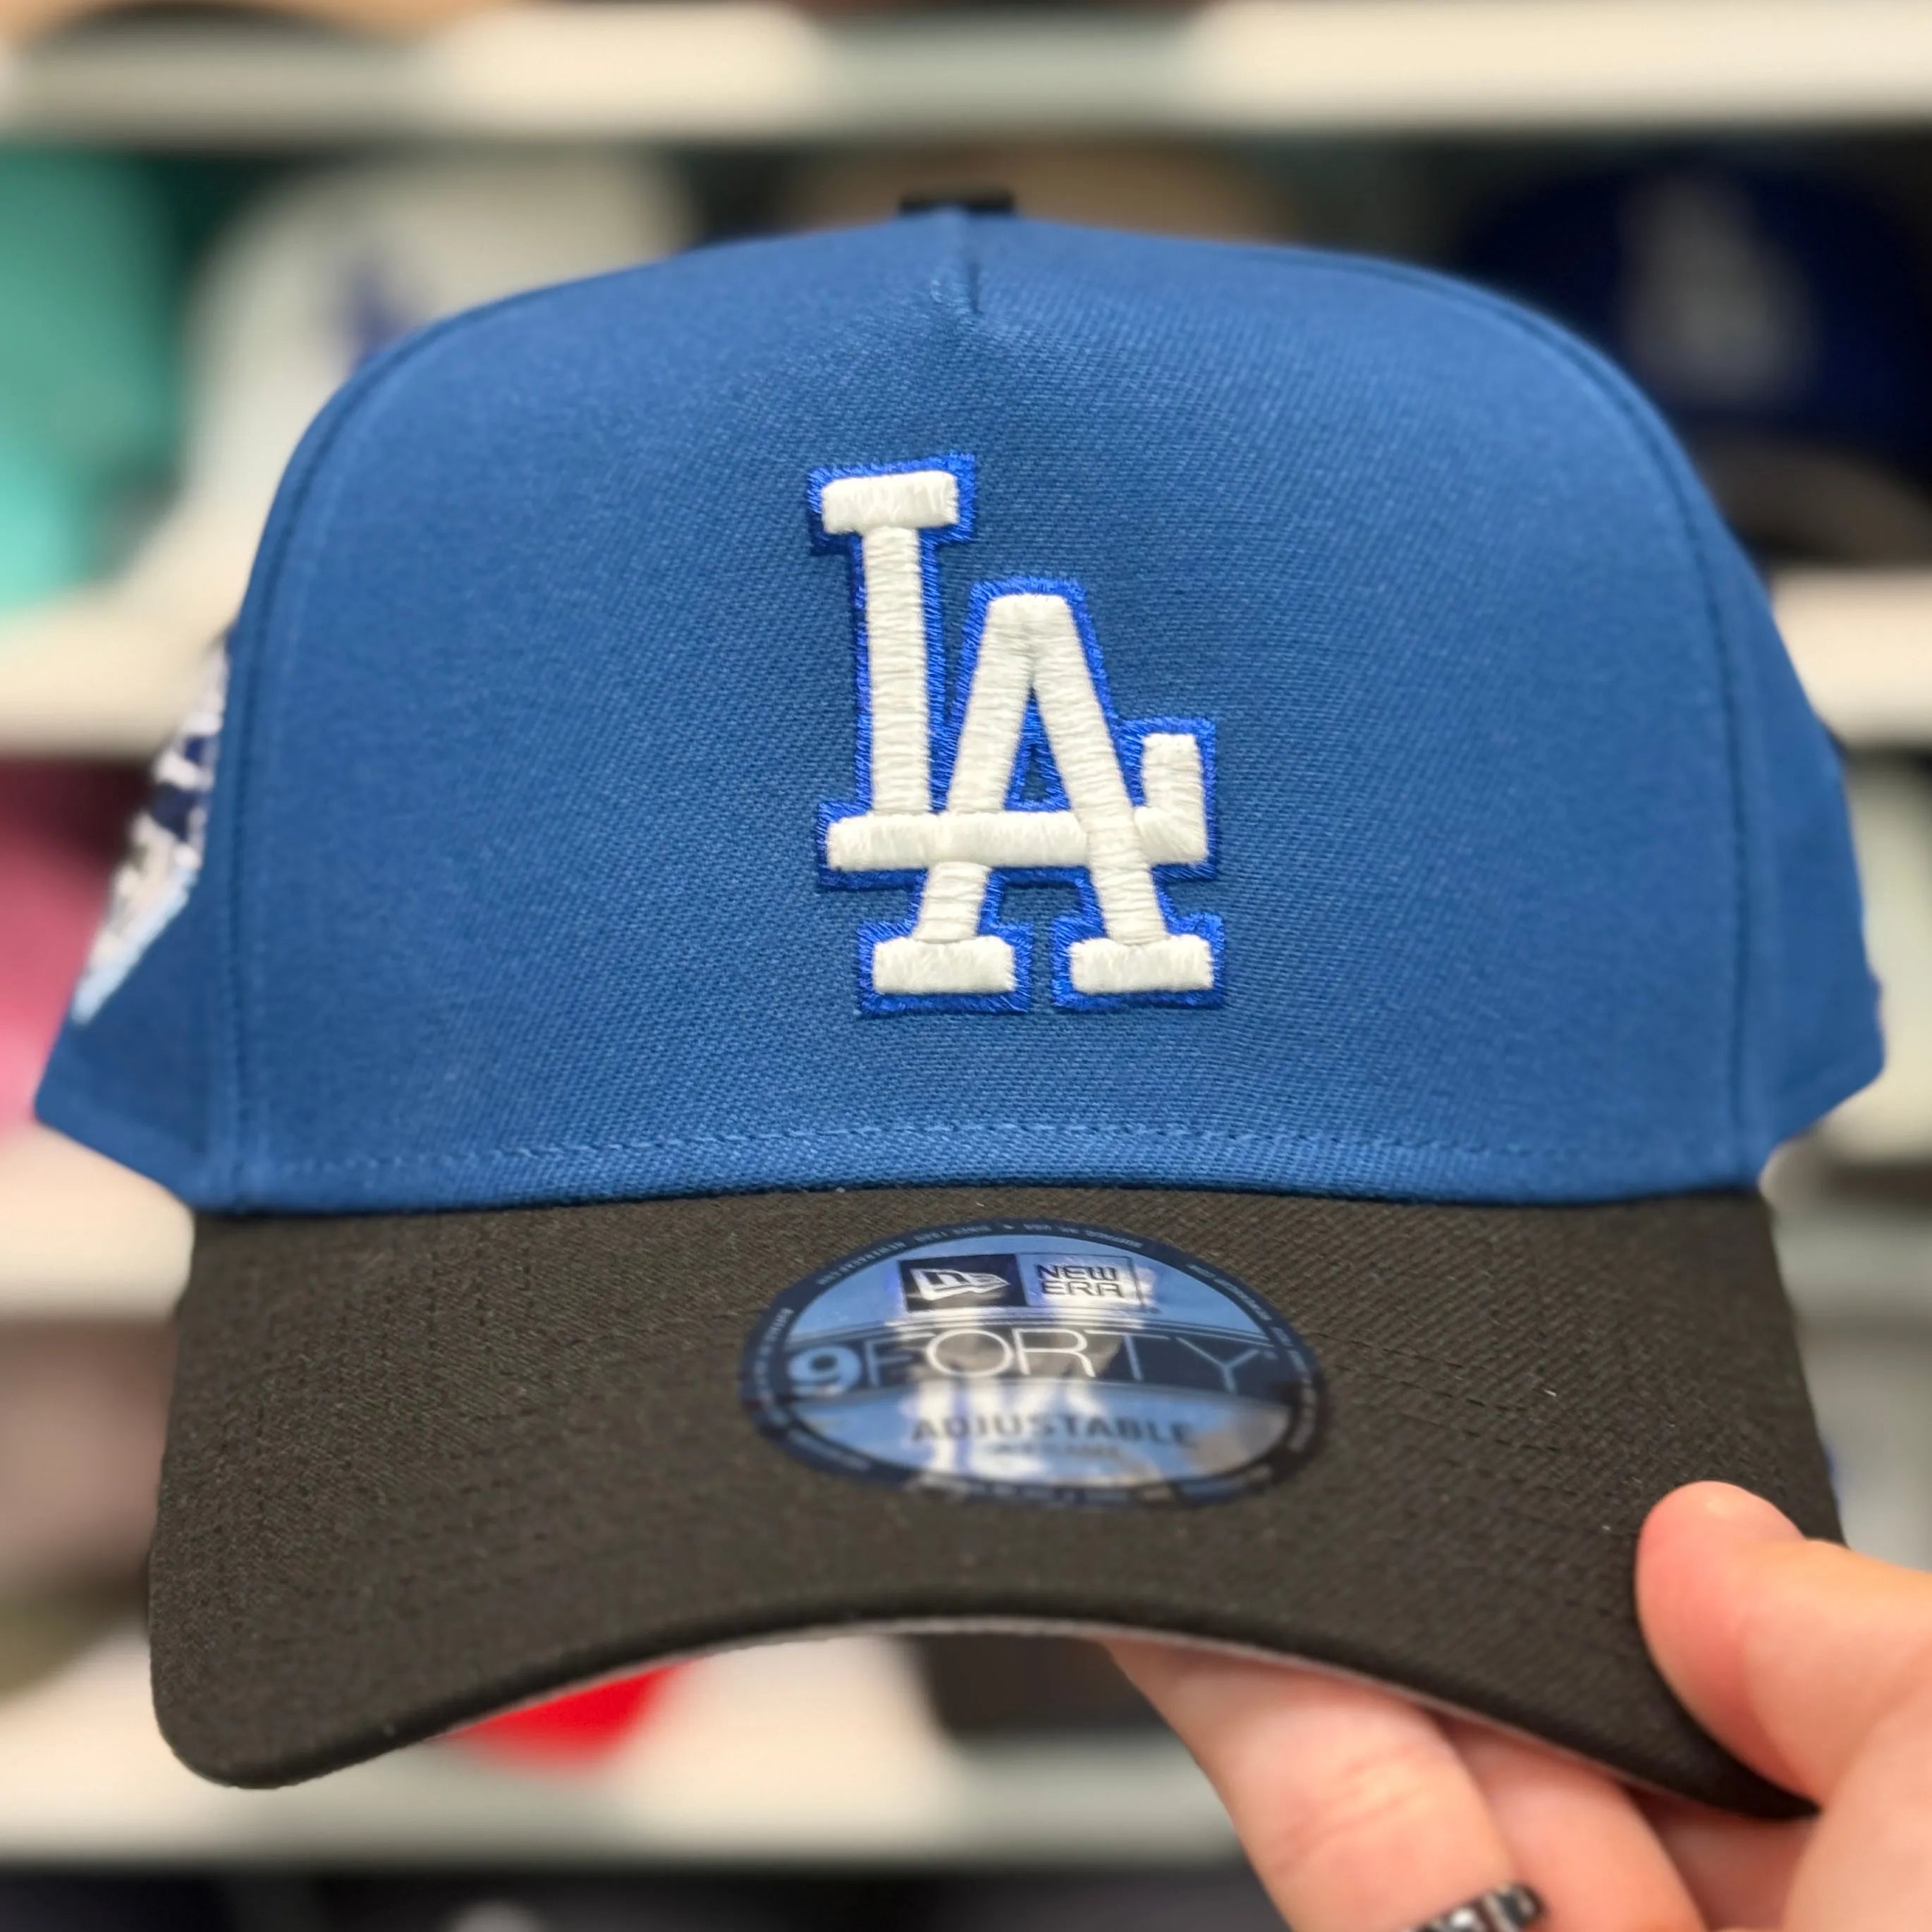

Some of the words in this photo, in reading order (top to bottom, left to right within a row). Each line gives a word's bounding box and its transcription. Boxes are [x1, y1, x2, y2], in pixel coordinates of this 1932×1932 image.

[814, 460, 1221, 1008] LA
[1034, 1264, 1119, 1283] NEW
[1040, 1281, 1127, 1298] ERA
[788, 1328, 1261, 1398] 9FORTY
[912, 1413, 1199, 1449] ADJUSTABLE
